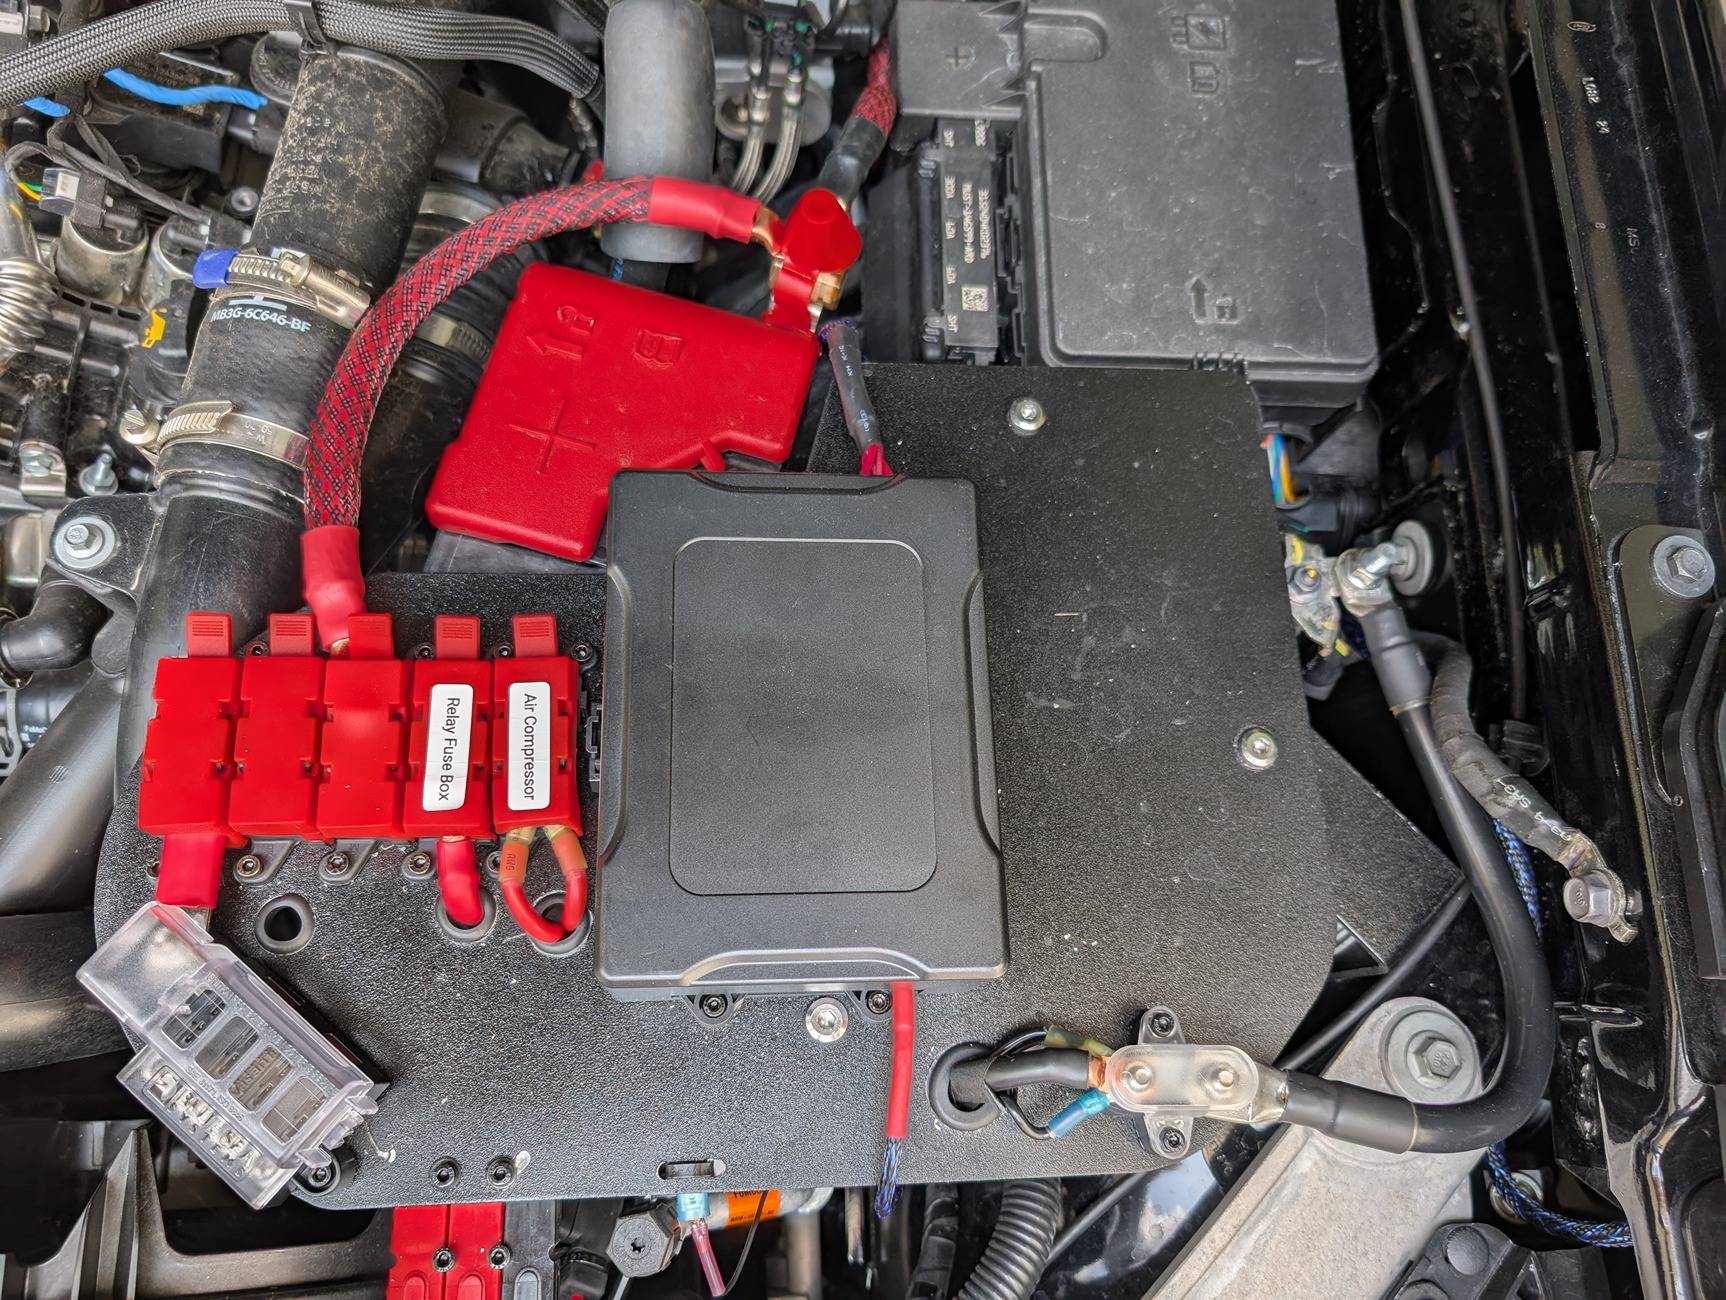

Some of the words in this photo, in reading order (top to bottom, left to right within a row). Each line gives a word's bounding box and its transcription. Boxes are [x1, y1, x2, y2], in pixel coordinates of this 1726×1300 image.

[210, 307, 312, 332] MB3G-6C646-BF
[442, 697, 461, 734] Relay
[524, 693, 538, 714] Air
[441, 738, 458, 771] Fuse
[521, 717, 538, 801] Compressor
[438, 775, 454, 801] Box
